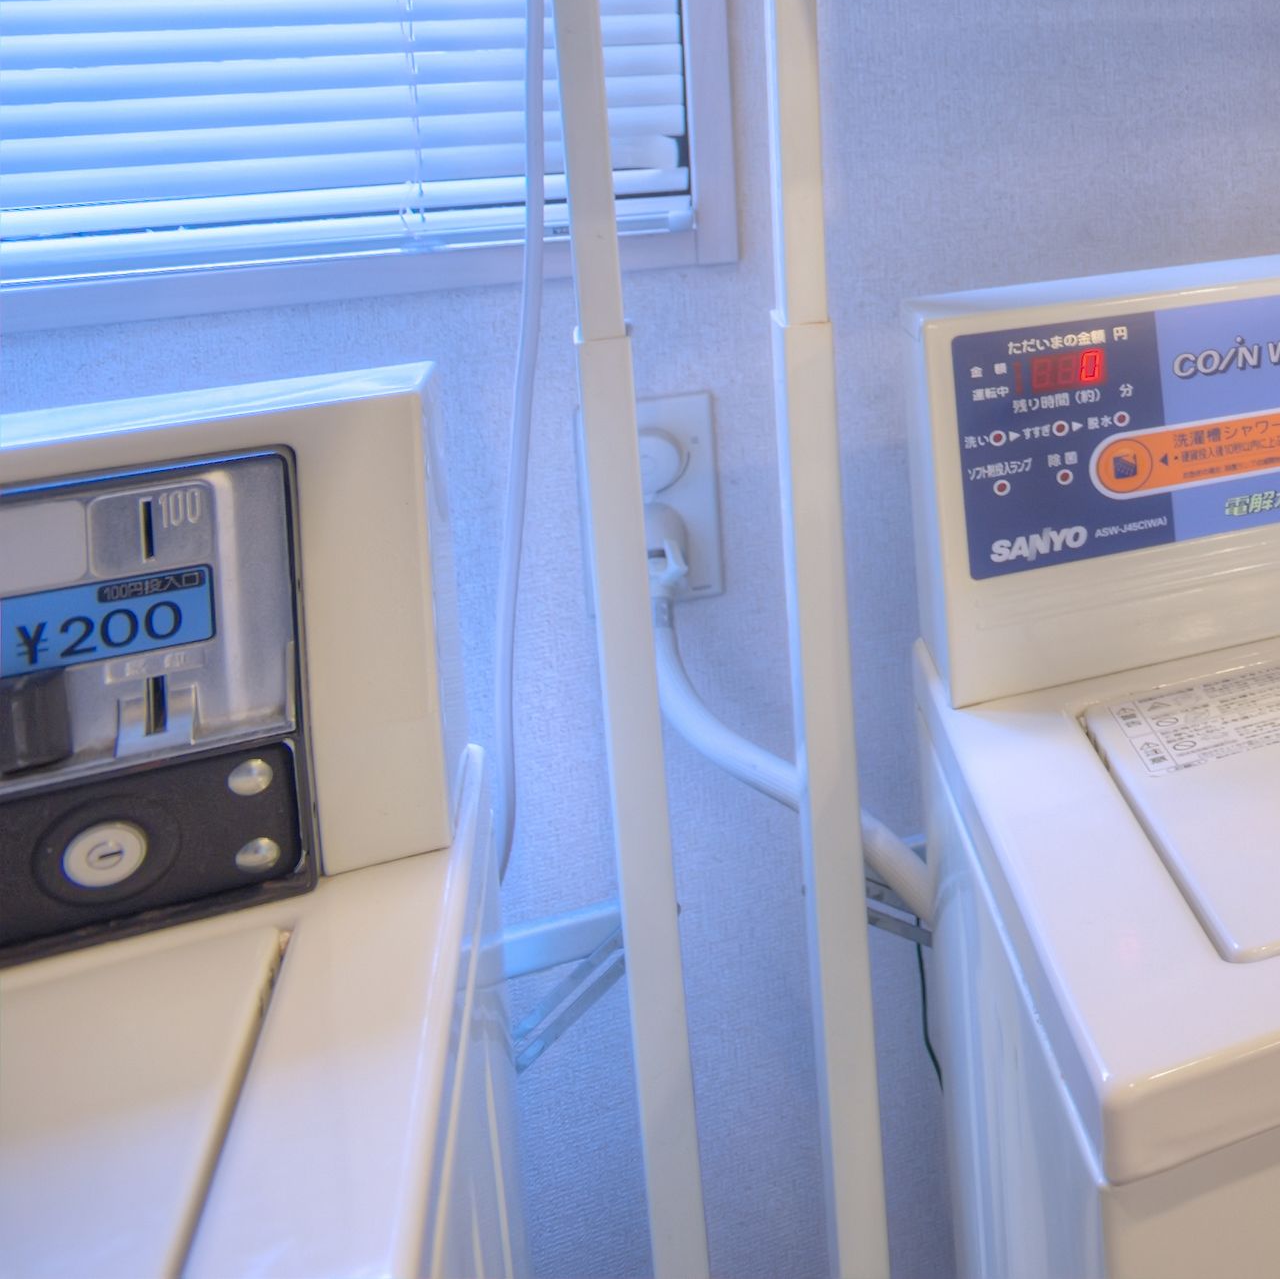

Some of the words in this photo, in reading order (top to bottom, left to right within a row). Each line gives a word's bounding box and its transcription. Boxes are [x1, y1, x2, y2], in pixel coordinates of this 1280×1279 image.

[1008, 329, 1106, 355] ただいまの金額
[1113, 326, 1128, 340] 円
[972, 386, 1010, 401] 運転中
[1119, 383, 1133, 398] 分
[964, 434, 990, 449] 洗い
[1022, 426, 1051, 440] すすぎ
[1047, 451, 1078, 467] 除菌
[159, 488, 201, 528] 100
[990, 526, 1088, 563] SANYO
[103, 571, 200, 601] 100円投入口
[16, 601, 183, 665] ¥200
